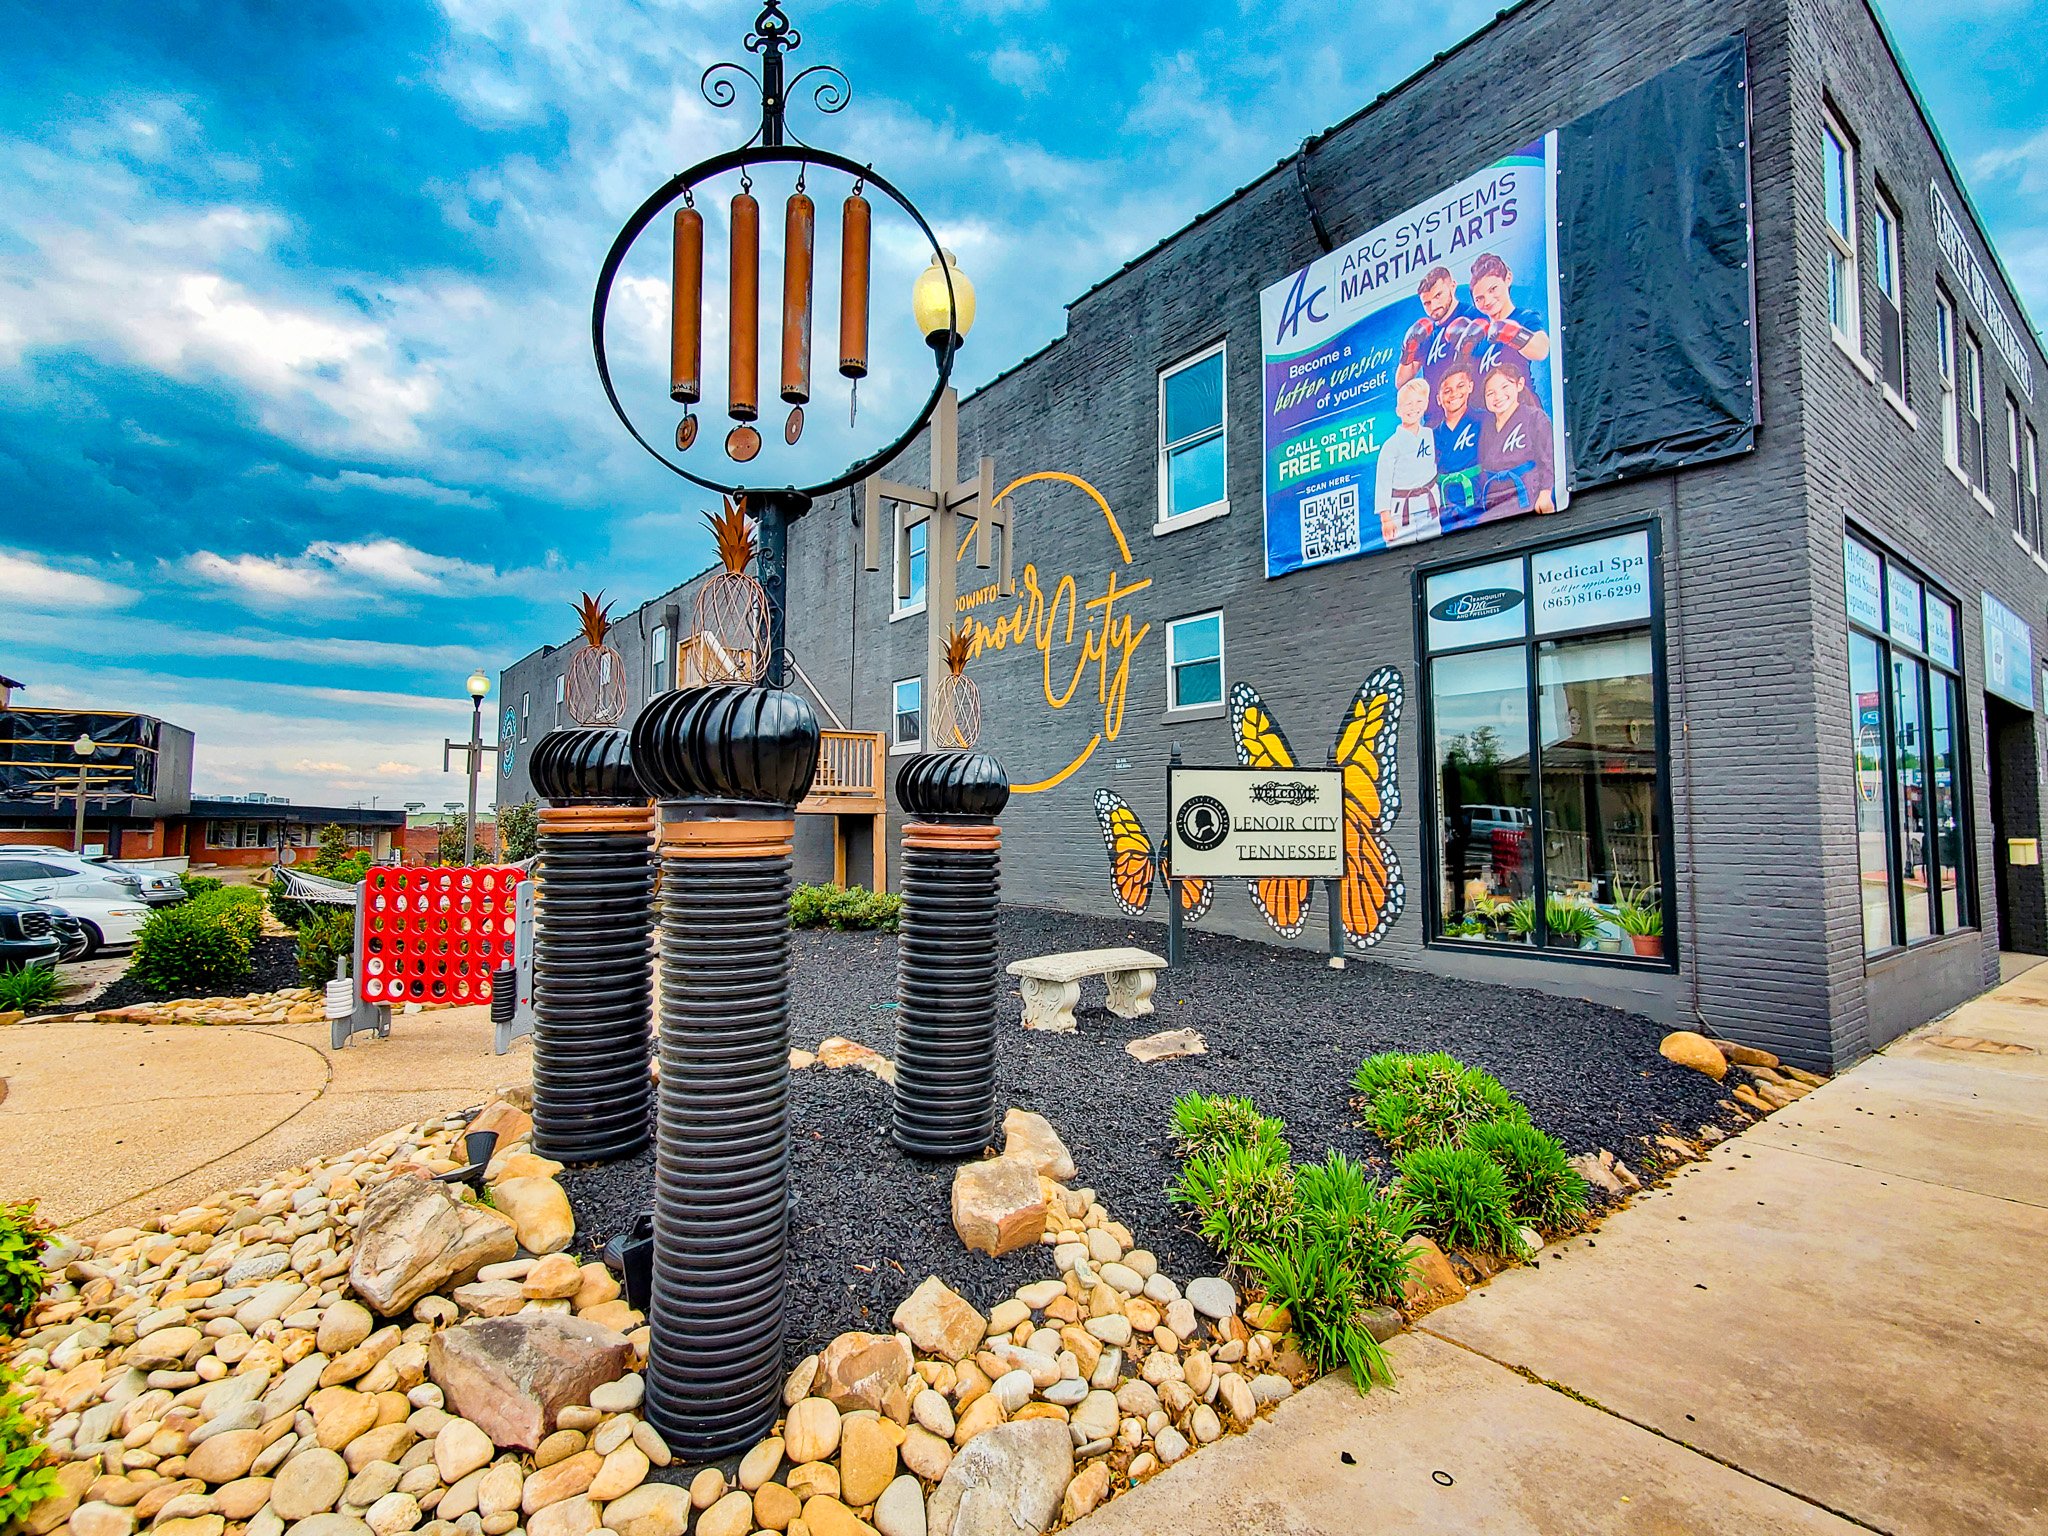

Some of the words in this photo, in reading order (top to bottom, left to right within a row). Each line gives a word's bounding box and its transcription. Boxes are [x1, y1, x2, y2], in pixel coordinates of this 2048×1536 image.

[1341, 238, 1387, 276] ARC
[1396, 172, 1516, 247] SYSTEMS
[1340, 238, 1441, 303] MARTIAL
[1450, 198, 1518, 254] ARTS
[1289, 352, 1340, 379] Become
[1344, 346, 1352, 357] a
[1273, 376, 1326, 416] better
[1330, 346, 1394, 387] version
[1316, 393, 1331, 409] of
[1333, 370, 1389, 407] yourself.
[1286, 438, 1317, 458] CALL
[1321, 433, 1337, 446] OR
[1340, 417, 1376, 440] TEXT
[1279, 450, 1322, 481] FREE
[1325, 433, 1381, 465] TRIAL
[1305, 482, 1326, 494] SCAN
[1329, 475, 1350, 487] HERE
[1538, 560, 1604, 585] Medical
[1611, 556, 1644, 573] Spa
[1542, 582, 1641, 611] (865)816-6299
[1551, 584, 1567, 594] Call
[1457, 594, 1487, 617] Spa
[1044, 571, 1152, 741] City
[1253, 788, 1316, 801] WELCOME
[1233, 816, 1295, 831] LENOIR
[1302, 816, 1339, 831] CITY
[1236, 845, 1338, 859] TENNESSEE
